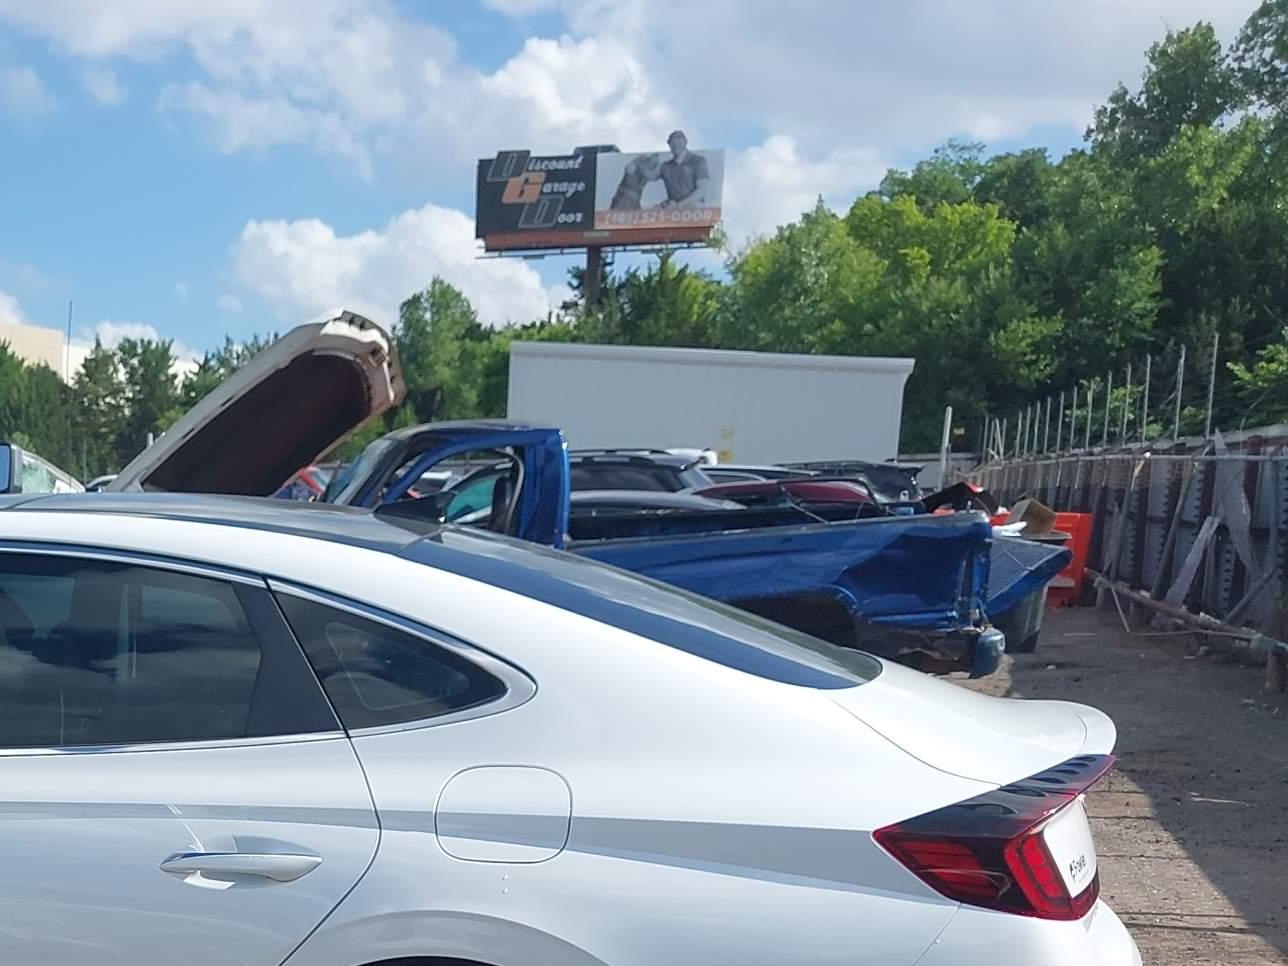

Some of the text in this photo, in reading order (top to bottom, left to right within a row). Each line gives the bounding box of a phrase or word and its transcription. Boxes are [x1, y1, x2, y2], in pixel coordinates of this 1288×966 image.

[486, 150, 584, 182] Discount
[502, 171, 586, 204] Garage
[518, 194, 584, 228] Door
